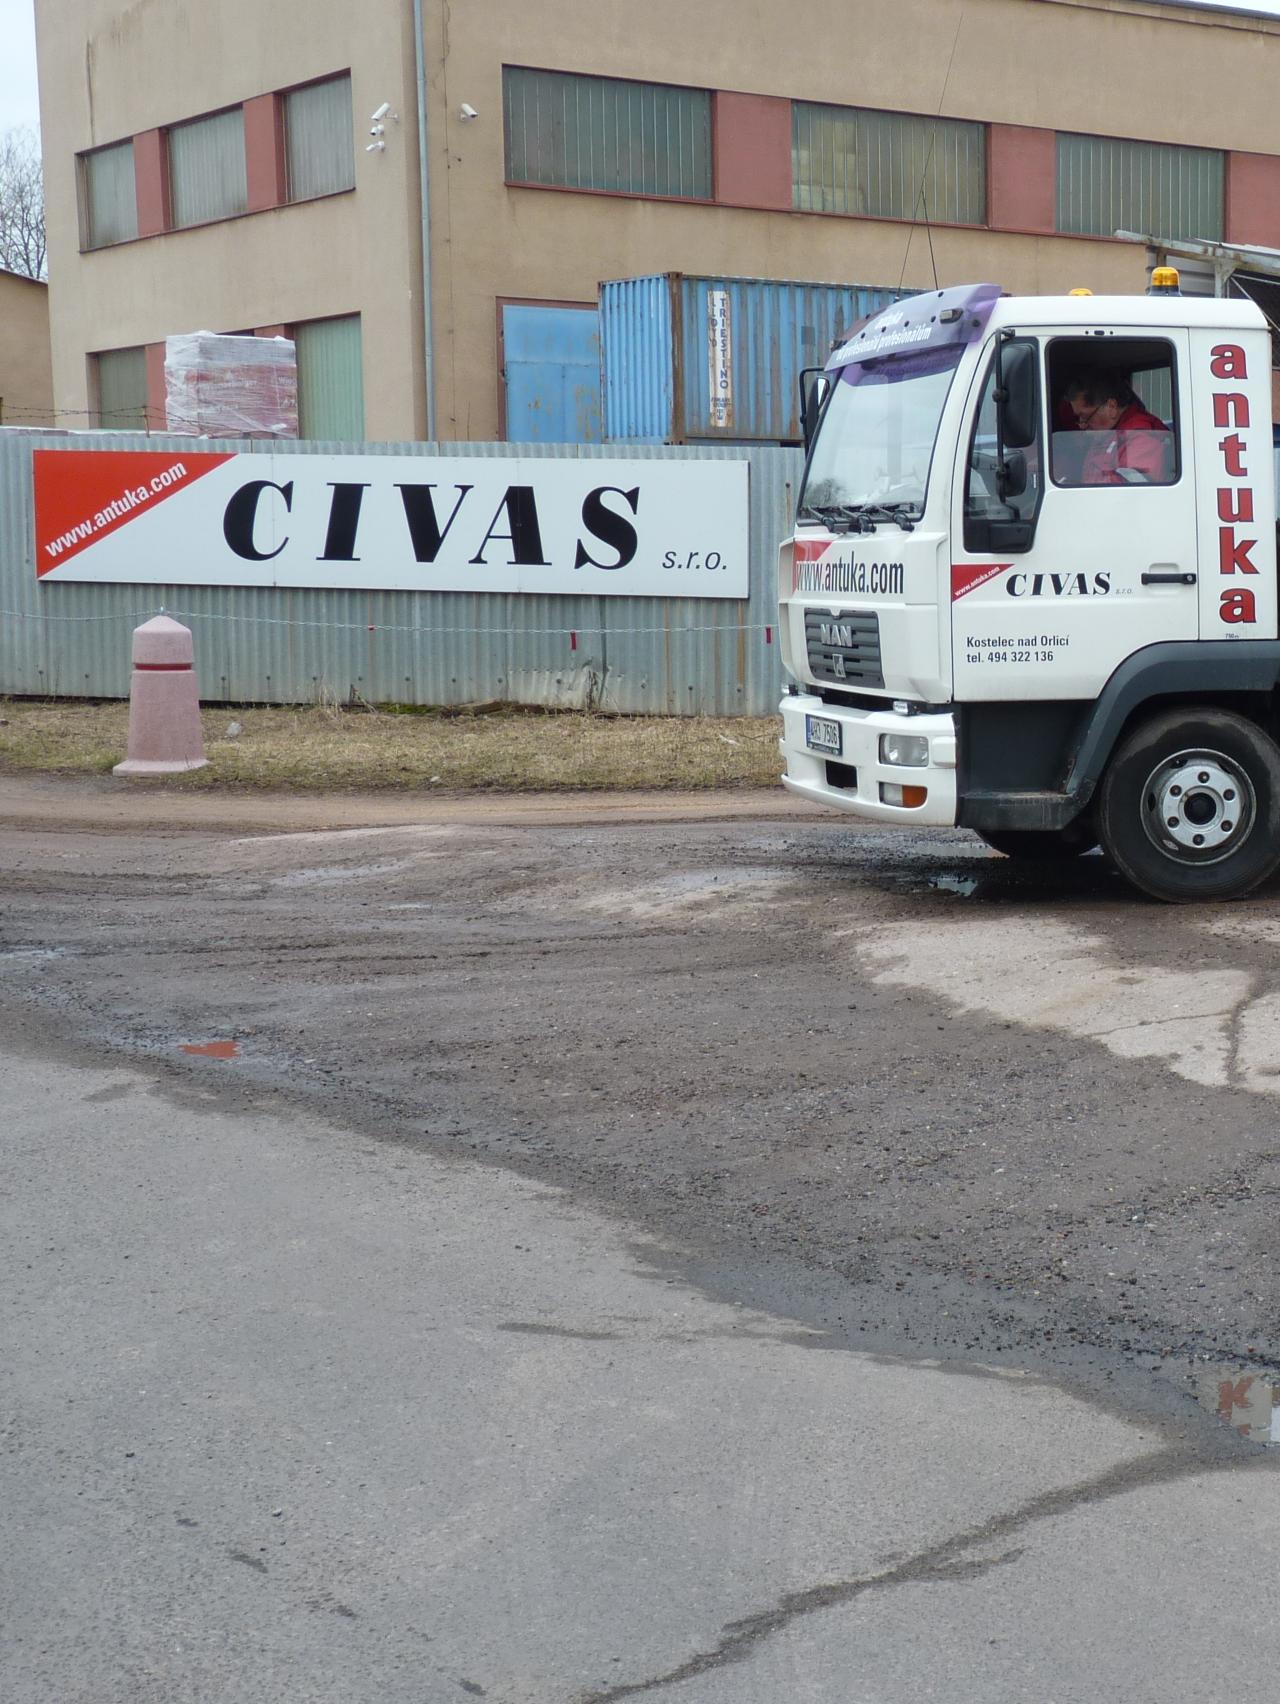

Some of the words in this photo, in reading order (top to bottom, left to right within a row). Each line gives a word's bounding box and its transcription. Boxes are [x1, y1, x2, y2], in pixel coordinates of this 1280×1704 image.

[719, 297, 729, 389] TRIESTINO
[1210, 342, 1260, 624] antuka
[45, 462, 188, 557] www.antuka.com
[223, 480, 640, 570] CIVAS
[662, 549, 728, 570] s.r.o.
[796, 551, 904, 594] www.antuka.com
[954, 566, 1001, 597] www.antuka.com
[1006, 571, 1111, 597] CIVAS
[820, 624, 853, 648] MAN
[966, 636, 1014, 648] Kostelec
[1017, 635, 1037, 647] nad
[1040, 634, 1070, 647] Orlicí
[966, 652, 985, 663] tel.
[987, 652, 1007, 663] 494
[1010, 651, 1031, 662] 322
[1035, 651, 1054, 662] 136
